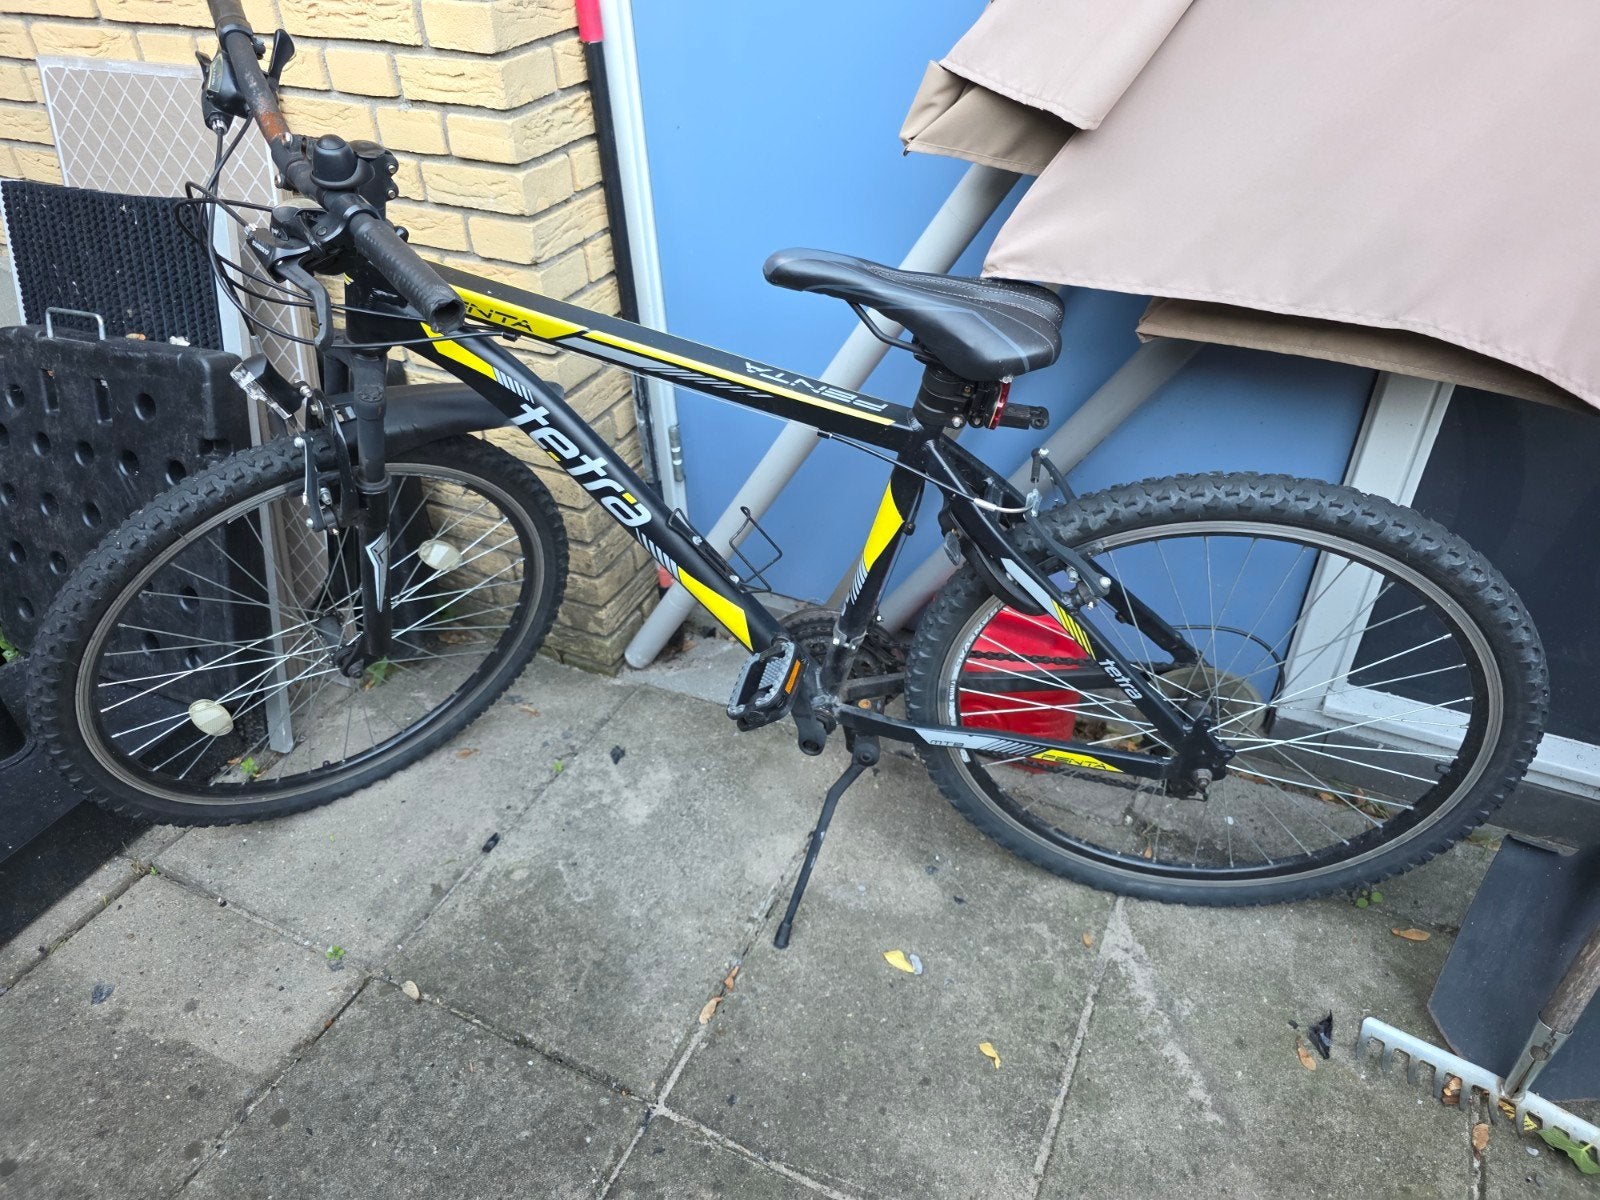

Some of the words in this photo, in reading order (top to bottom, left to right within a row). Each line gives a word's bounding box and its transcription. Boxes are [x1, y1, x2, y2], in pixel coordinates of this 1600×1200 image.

[463, 301, 533, 333] NTA
[745, 361, 889, 412] PENTA
[510, 403, 652, 527] tetra
[1098, 658, 1143, 700] tetra
[1041, 754, 1107, 770] PENTA
